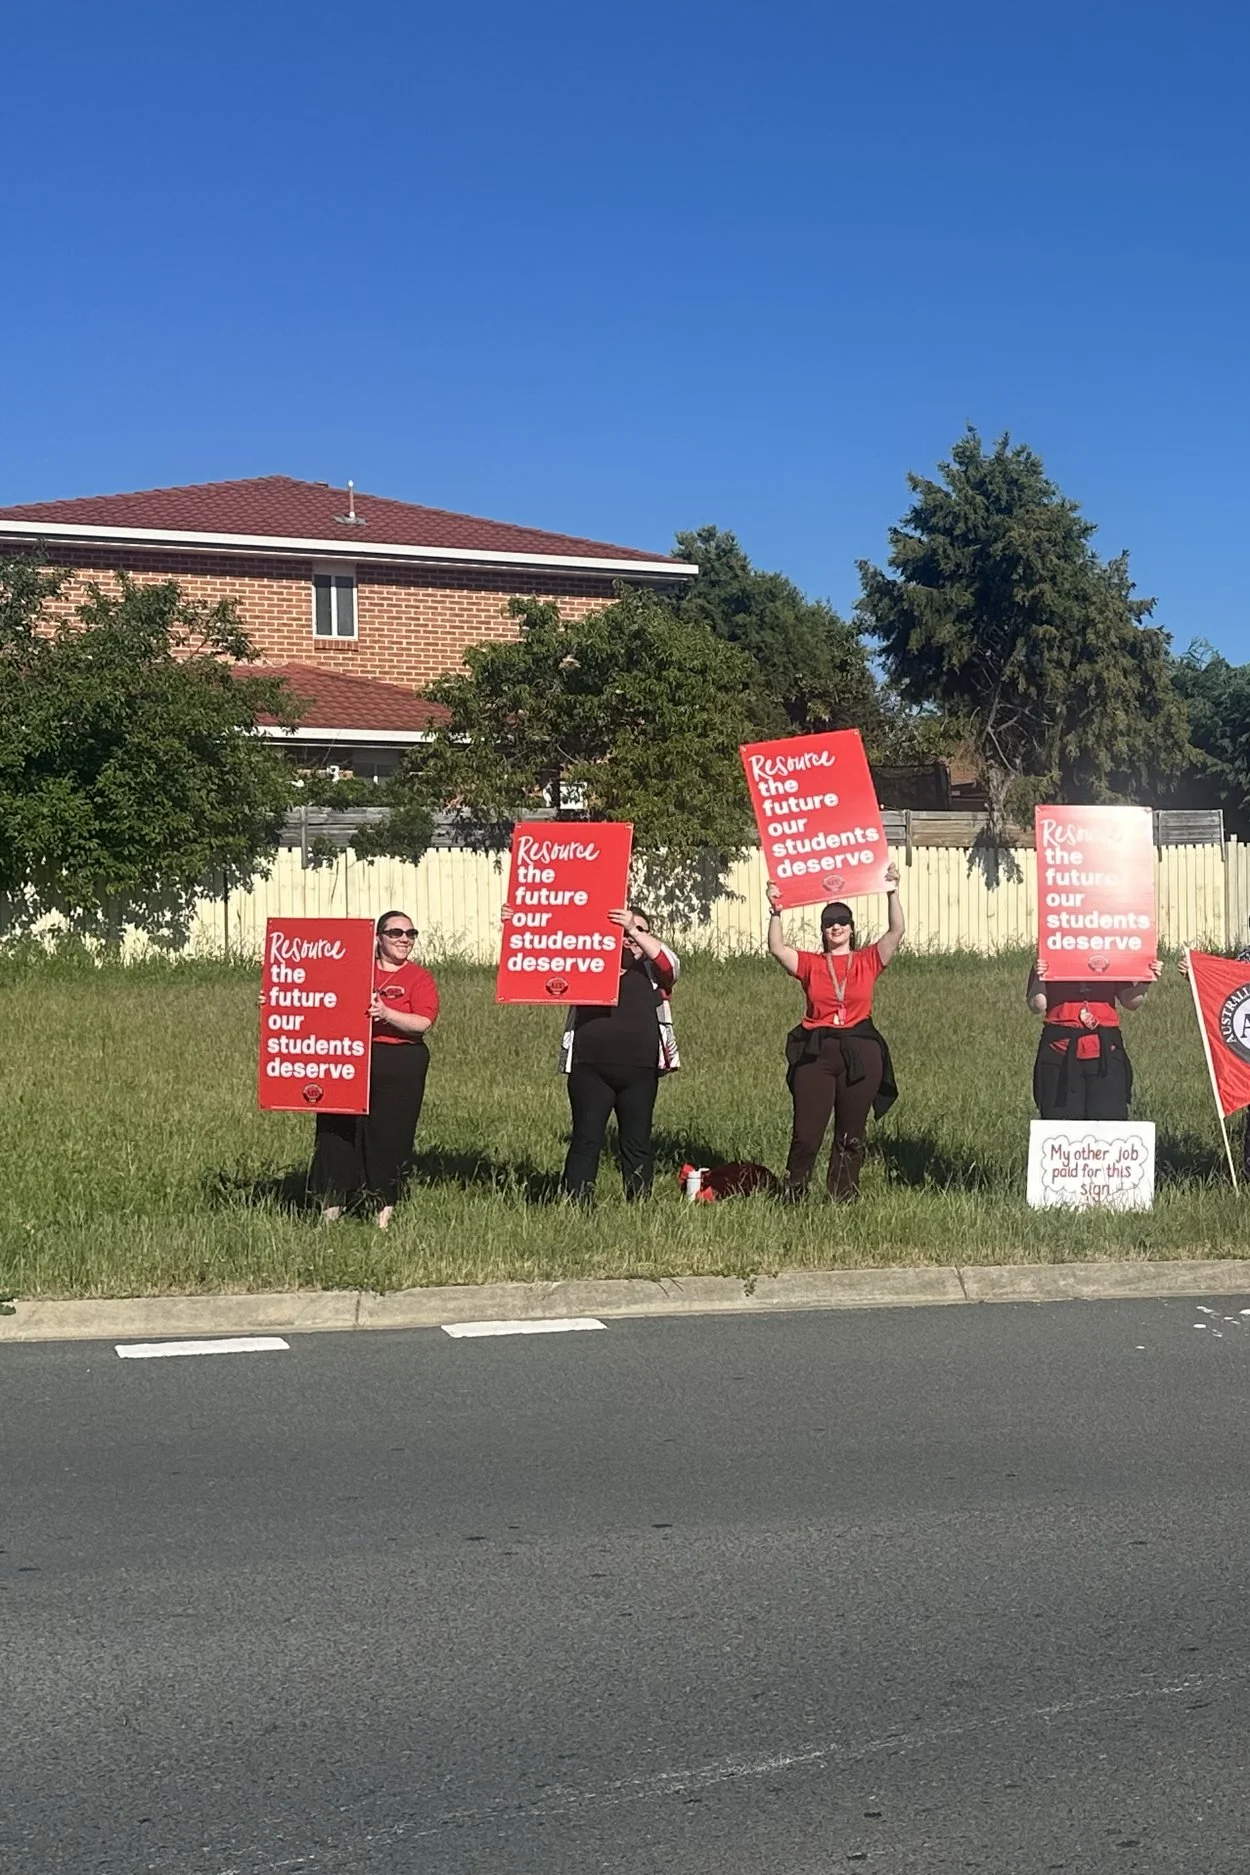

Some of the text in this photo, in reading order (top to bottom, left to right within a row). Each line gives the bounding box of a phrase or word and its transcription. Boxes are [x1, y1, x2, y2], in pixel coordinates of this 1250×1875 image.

[748, 750, 836, 782] Resource
[758, 778, 798, 797] the
[762, 793, 838, 817] future
[768, 817, 807, 836] our
[517, 836, 600, 866] Resource
[772, 827, 879, 857] students
[776, 849, 874, 878] deserve
[1045, 847, 1083, 865] the
[518, 866, 555, 883] the
[515, 887, 588, 905] future
[1046, 893, 1085, 907] our
[512, 912, 552, 927] our
[1047, 911, 1150, 929] students
[269, 932, 345, 964] Resource
[510, 931, 616, 950] students
[1047, 932, 1142, 950] deserve
[507, 953, 604, 972] deserve
[270, 964, 305, 984] the
[270, 987, 337, 1008] future
[268, 1014, 304, 1030] our
[267, 1035, 364, 1056] students
[267, 1057, 355, 1079] deserve
[1051, 1143, 1139, 1167] My other job
[1052, 1162, 1131, 1184] paid for this
[1080, 1183, 1110, 1201] sign
